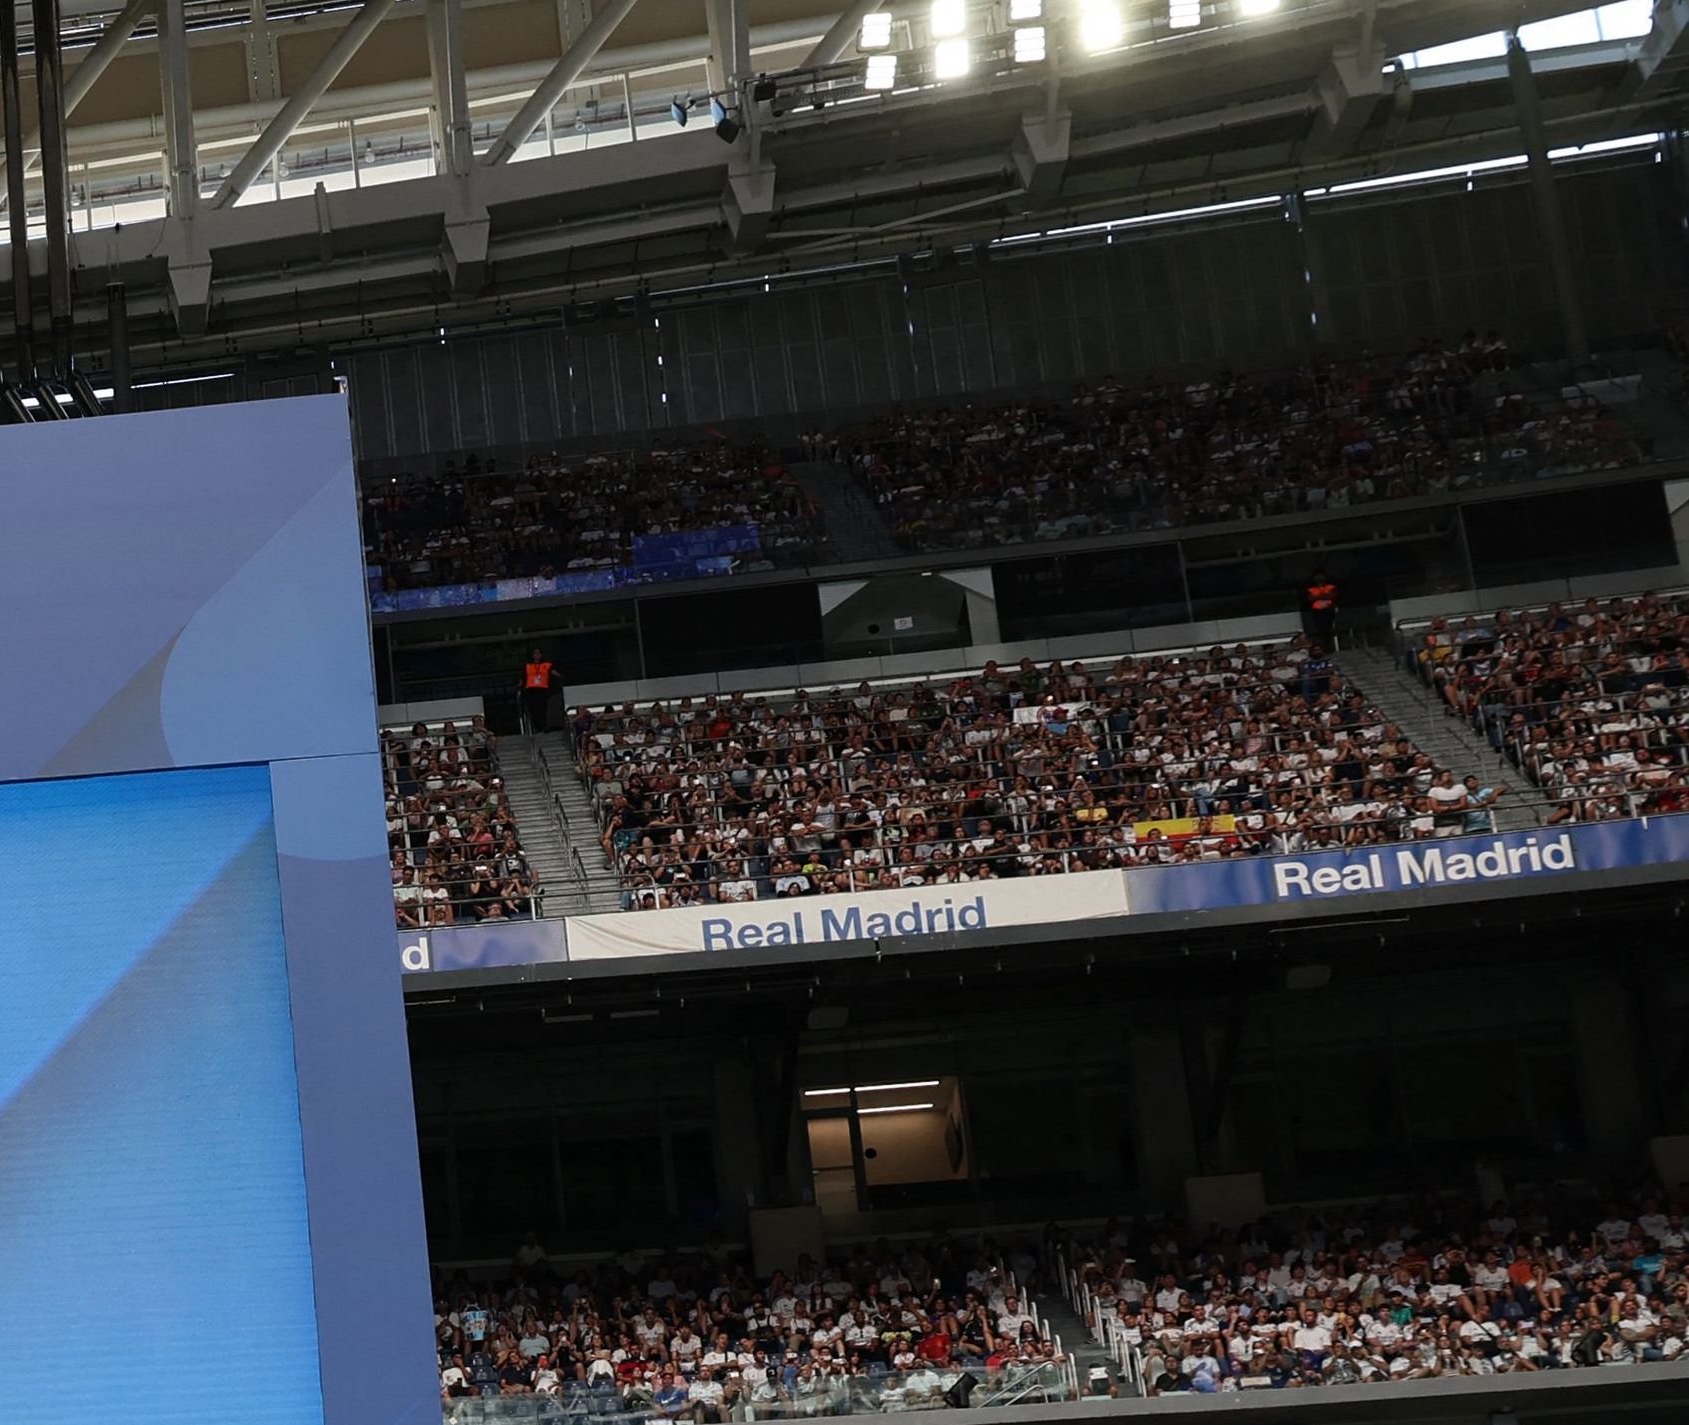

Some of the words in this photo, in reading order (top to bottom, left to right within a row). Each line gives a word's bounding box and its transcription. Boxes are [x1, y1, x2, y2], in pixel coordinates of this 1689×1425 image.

[1273, 853, 1384, 898] Real
[1398, 834, 1575, 886] Madrid
[701, 911, 803, 951] Real
[822, 896, 987, 939] Madrid
